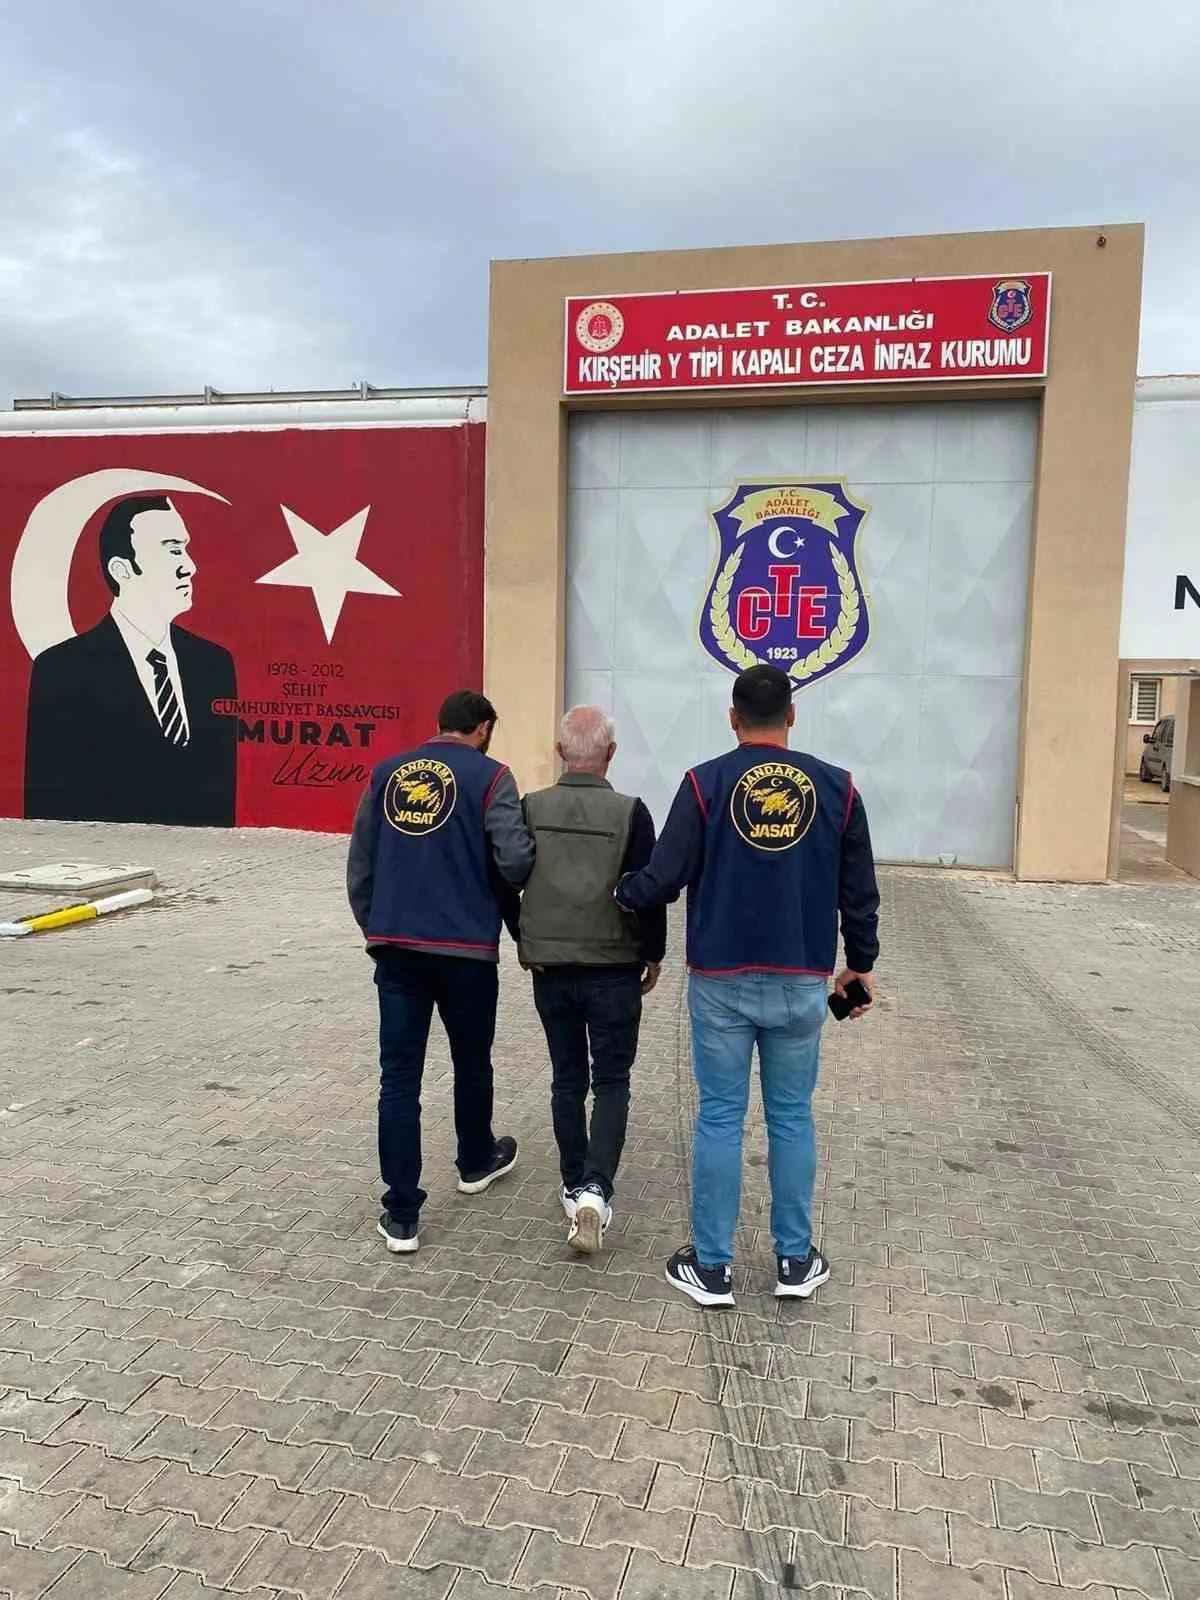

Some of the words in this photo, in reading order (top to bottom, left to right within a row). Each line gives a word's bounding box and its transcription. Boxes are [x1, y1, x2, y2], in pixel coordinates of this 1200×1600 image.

[772, 294, 793, 310] T.
[800, 292, 826, 307] C.
[666, 321, 770, 341] ADALET
[786, 309, 935, 336] BAKANLIĞI
[578, 349, 662, 388] KIRŞEHİR
[668, 352, 682, 379] Y
[689, 345, 723, 378] TİPİ
[732, 348, 801, 376] KAPALI
[810, 345, 864, 373] CEZA
[874, 338, 931, 371] İNFAZ
[941, 337, 1032, 368] KURUMU
[766, 499, 810, 508] ADALET
[755, 507, 821, 520] BAKANLIĞI
[736, 565, 828, 640] CTE
[767, 647, 798, 659] 1923
[267, 663, 299, 676] 1978
[311, 663, 344, 678] 2012
[213, 700, 313, 716] CUMHURİYET
[236, 719, 376, 747] MURAT
[396, 761, 453, 786] JANDARMA
[741, 766, 812, 794] JANDARMA
[394, 810, 437, 825] JASAT
[750, 823, 798, 837] JASAT
